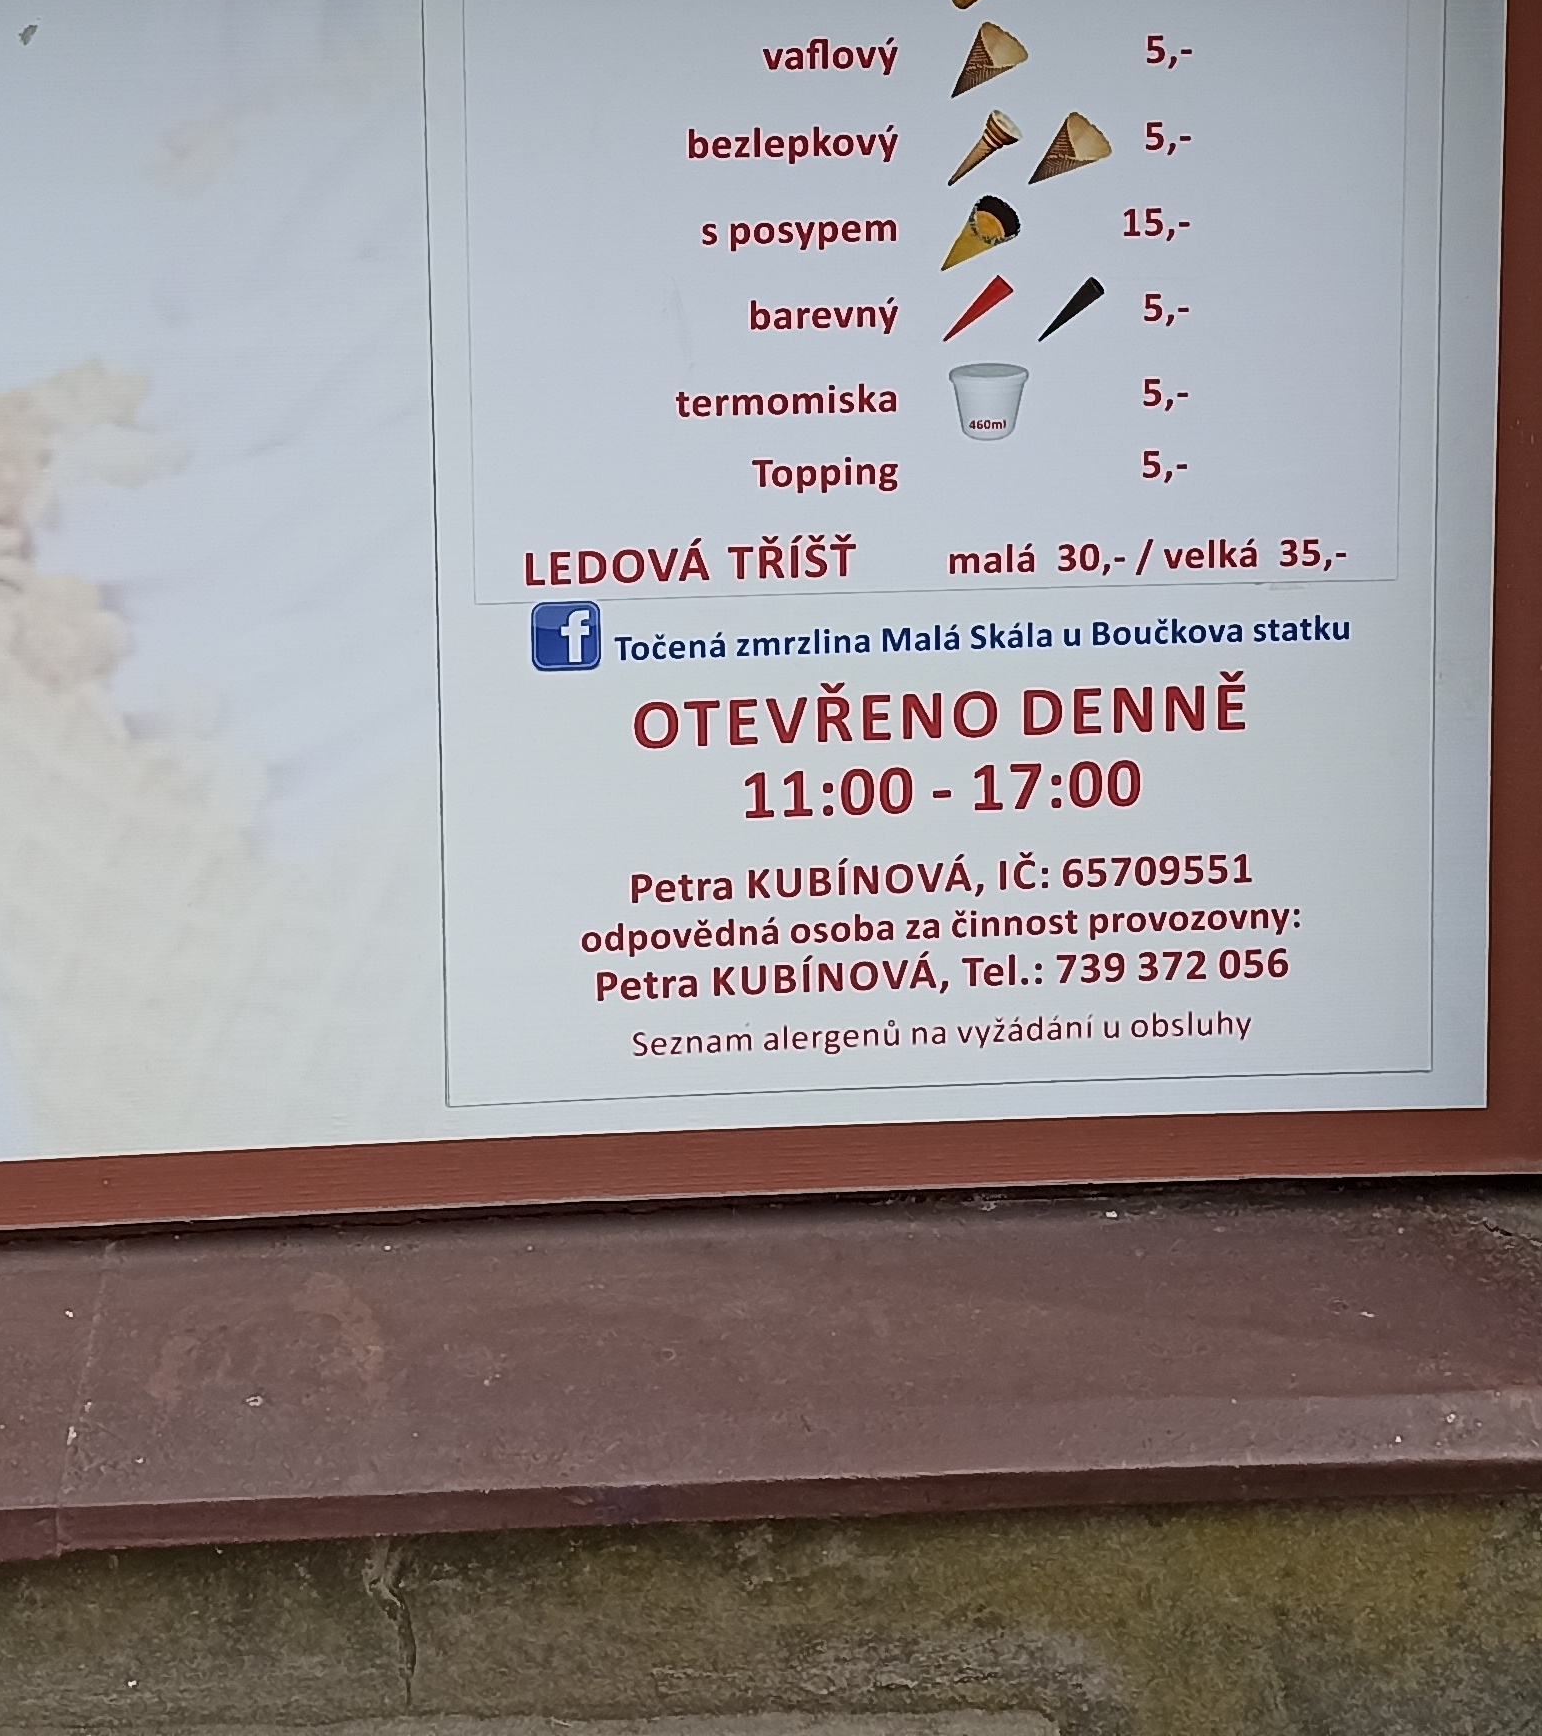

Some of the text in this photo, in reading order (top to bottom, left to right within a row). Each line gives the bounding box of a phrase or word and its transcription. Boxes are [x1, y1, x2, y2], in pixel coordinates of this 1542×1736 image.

[763, 35, 1192, 75] vaflový 5,-
[689, 122, 1191, 164] bezlepkový 5,-
[703, 208, 1190, 251] s posypem 15,-
[751, 294, 1189, 334] barevný 5,-
[676, 379, 1188, 417] termomiska 5,-
[969, 419, 1007, 430] 460ml
[752, 451, 1187, 493] Topping 5,-
[526, 534, 856, 586] LEDOVÁ TŘÍŠŤ
[950, 538, 1346, 576] malá 30,- / velká 35,-
[614, 615, 1349, 660] Točená zmrzlina Malá Skála u Boučkova statku
[634, 671, 1245, 749] OTEVŘENO DENNĚ
[745, 760, 1140, 818] 11:00 - 17:00
[632, 852, 1252, 903] Petra KUBÍNOVÁ, IČ: 65709551
[582, 909, 1300, 957] odpovědná osoba za činnost provozovny:
[597, 948, 1288, 1001] Petra KUBÍNOVÁ, Tel.: 739 372 056
[633, 1011, 1251, 1056] Seznam alergenů na vyžádání u obsluhy
